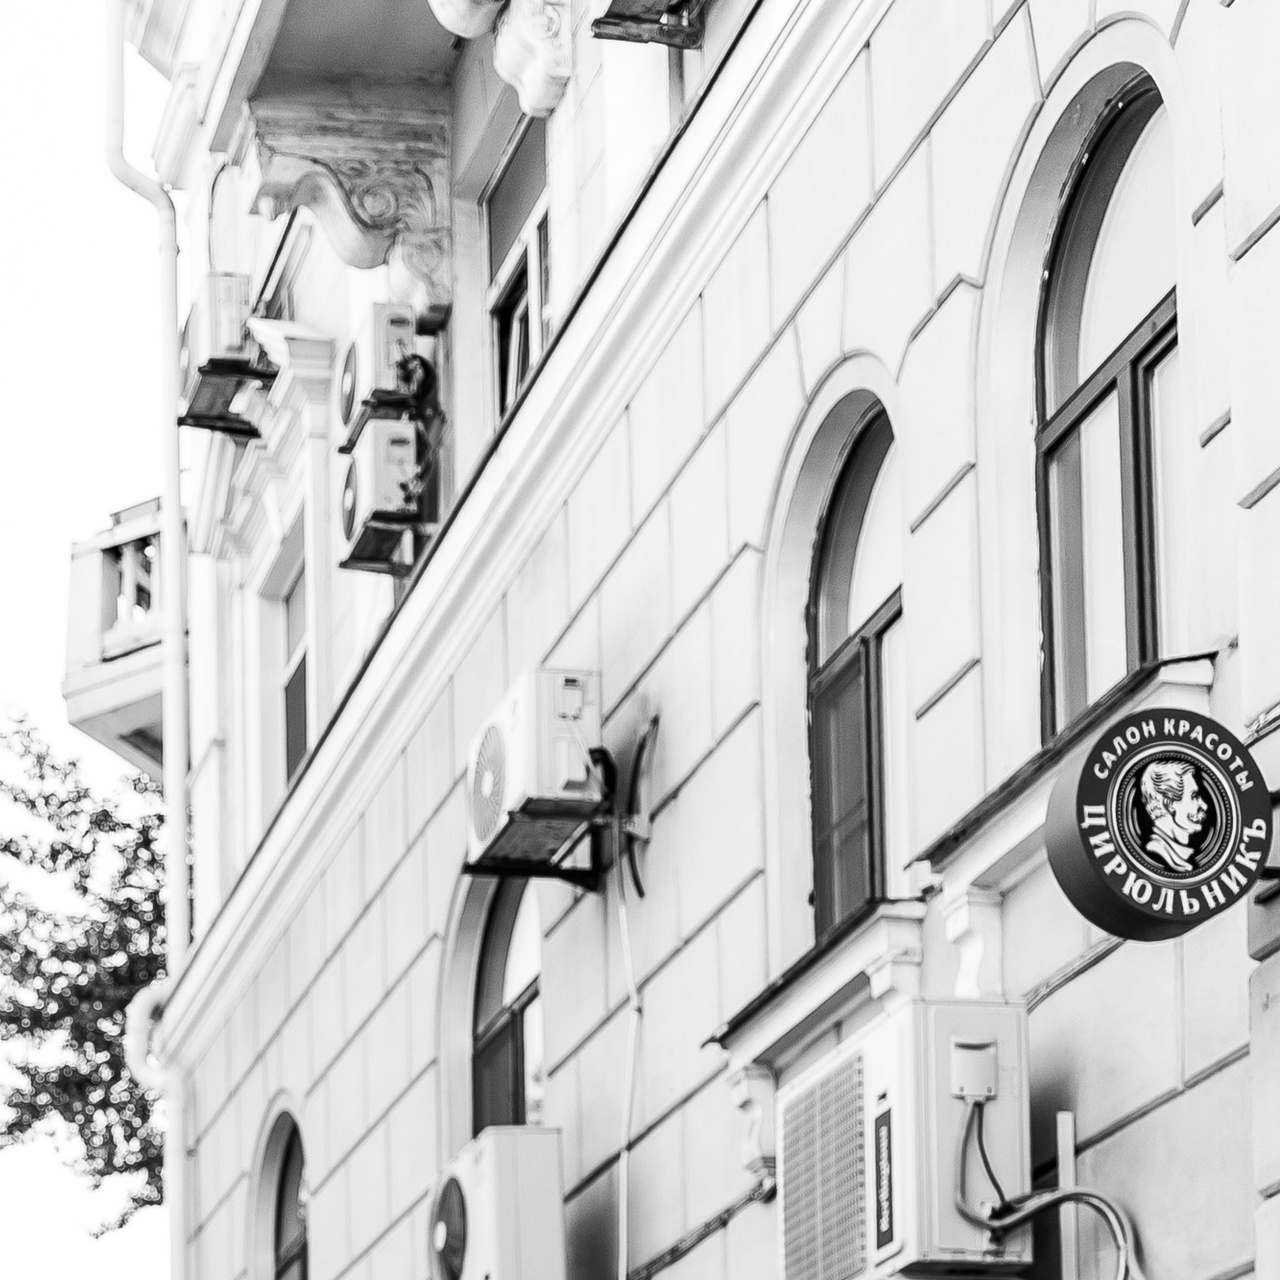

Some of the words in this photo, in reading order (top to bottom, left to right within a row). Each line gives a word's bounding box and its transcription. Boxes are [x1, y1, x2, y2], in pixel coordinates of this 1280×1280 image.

[1093, 718, 1156, 780] САЛОН
[1163, 717, 1254, 792] КРАСОТЫ
[1080, 804, 1268, 916] ЦИРЮЛЬНИКЪ
